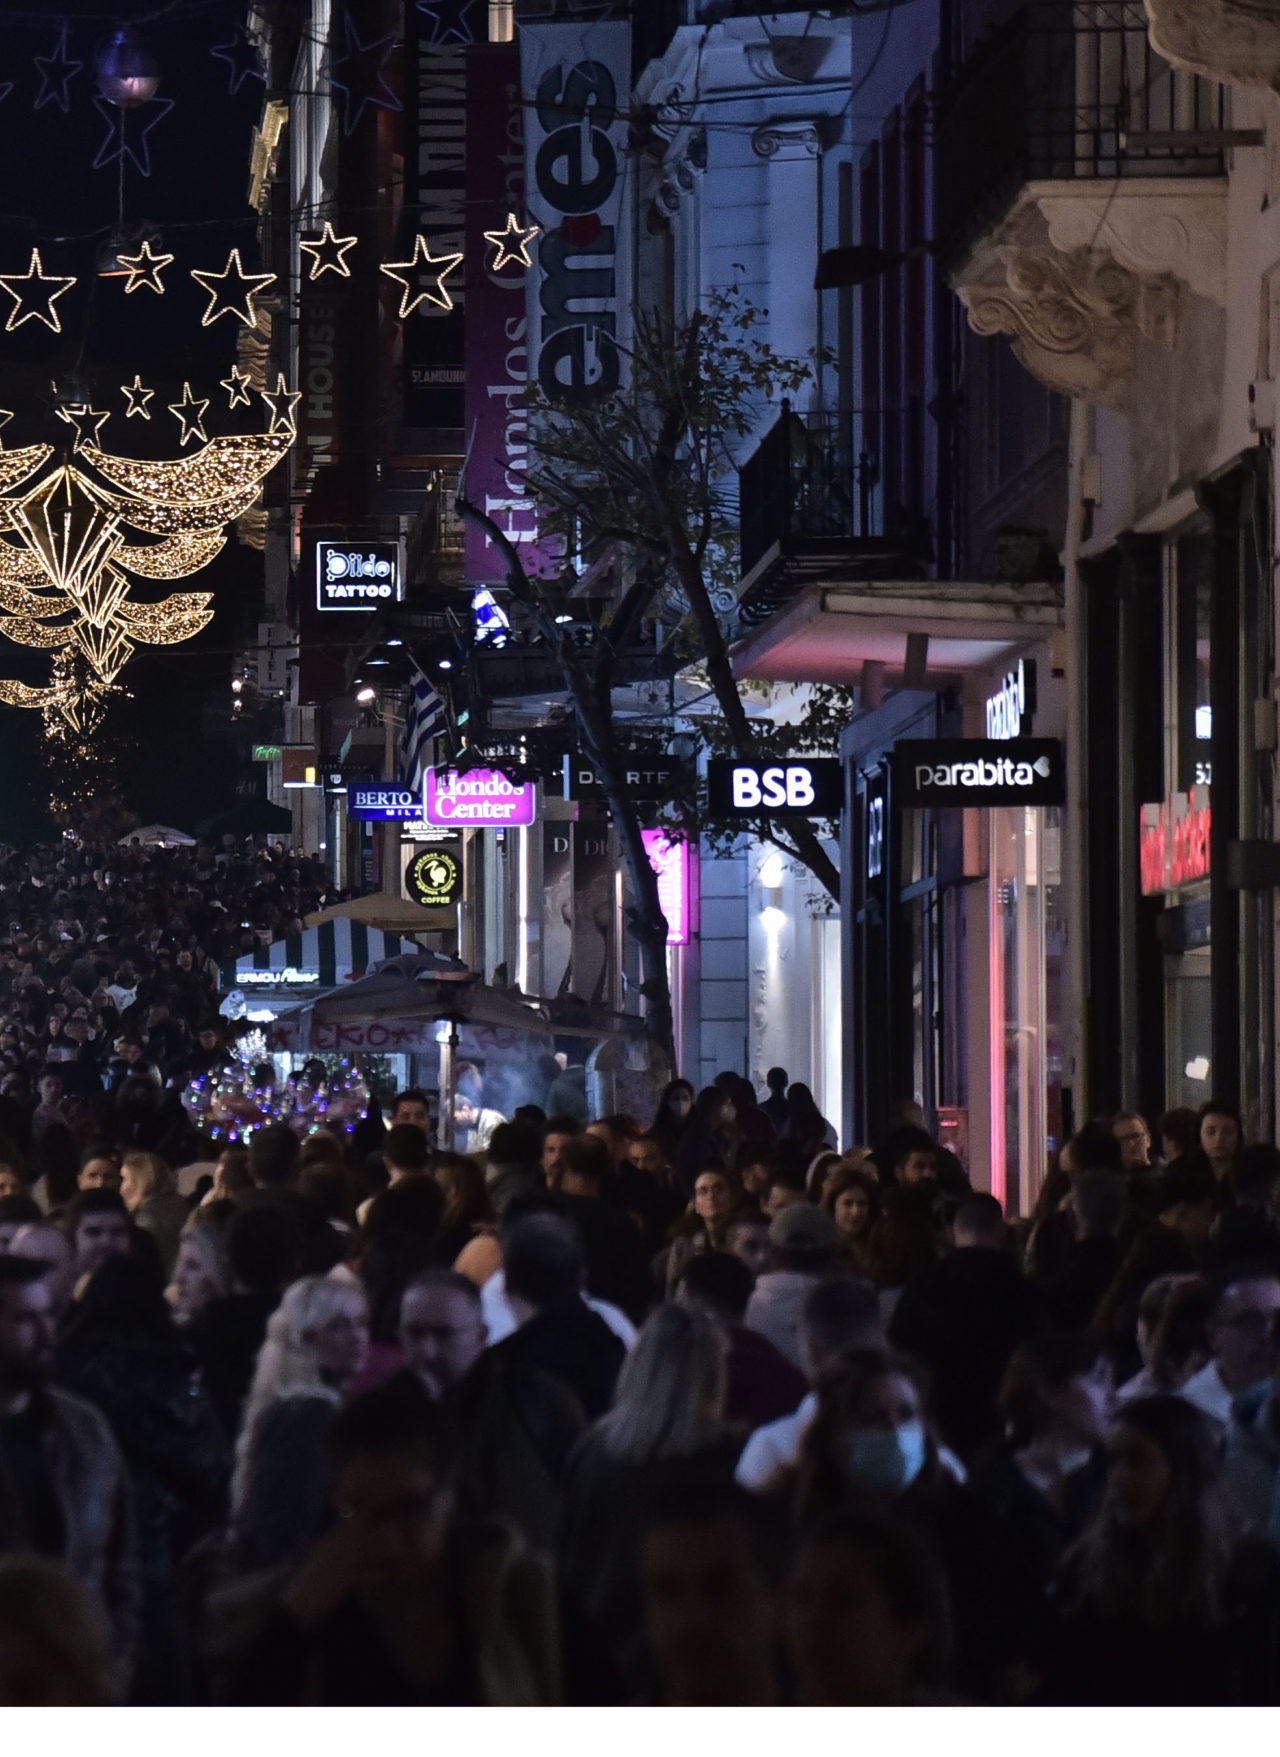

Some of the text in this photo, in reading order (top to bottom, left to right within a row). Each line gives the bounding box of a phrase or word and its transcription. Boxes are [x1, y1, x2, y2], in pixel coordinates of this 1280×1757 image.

[325, 584, 392, 598] TATTOO
[915, 757, 1034, 791] parabita
[733, 767, 815, 807] BSB
[435, 797, 516, 819] Center
[421, 896, 451, 904] COFFEE
